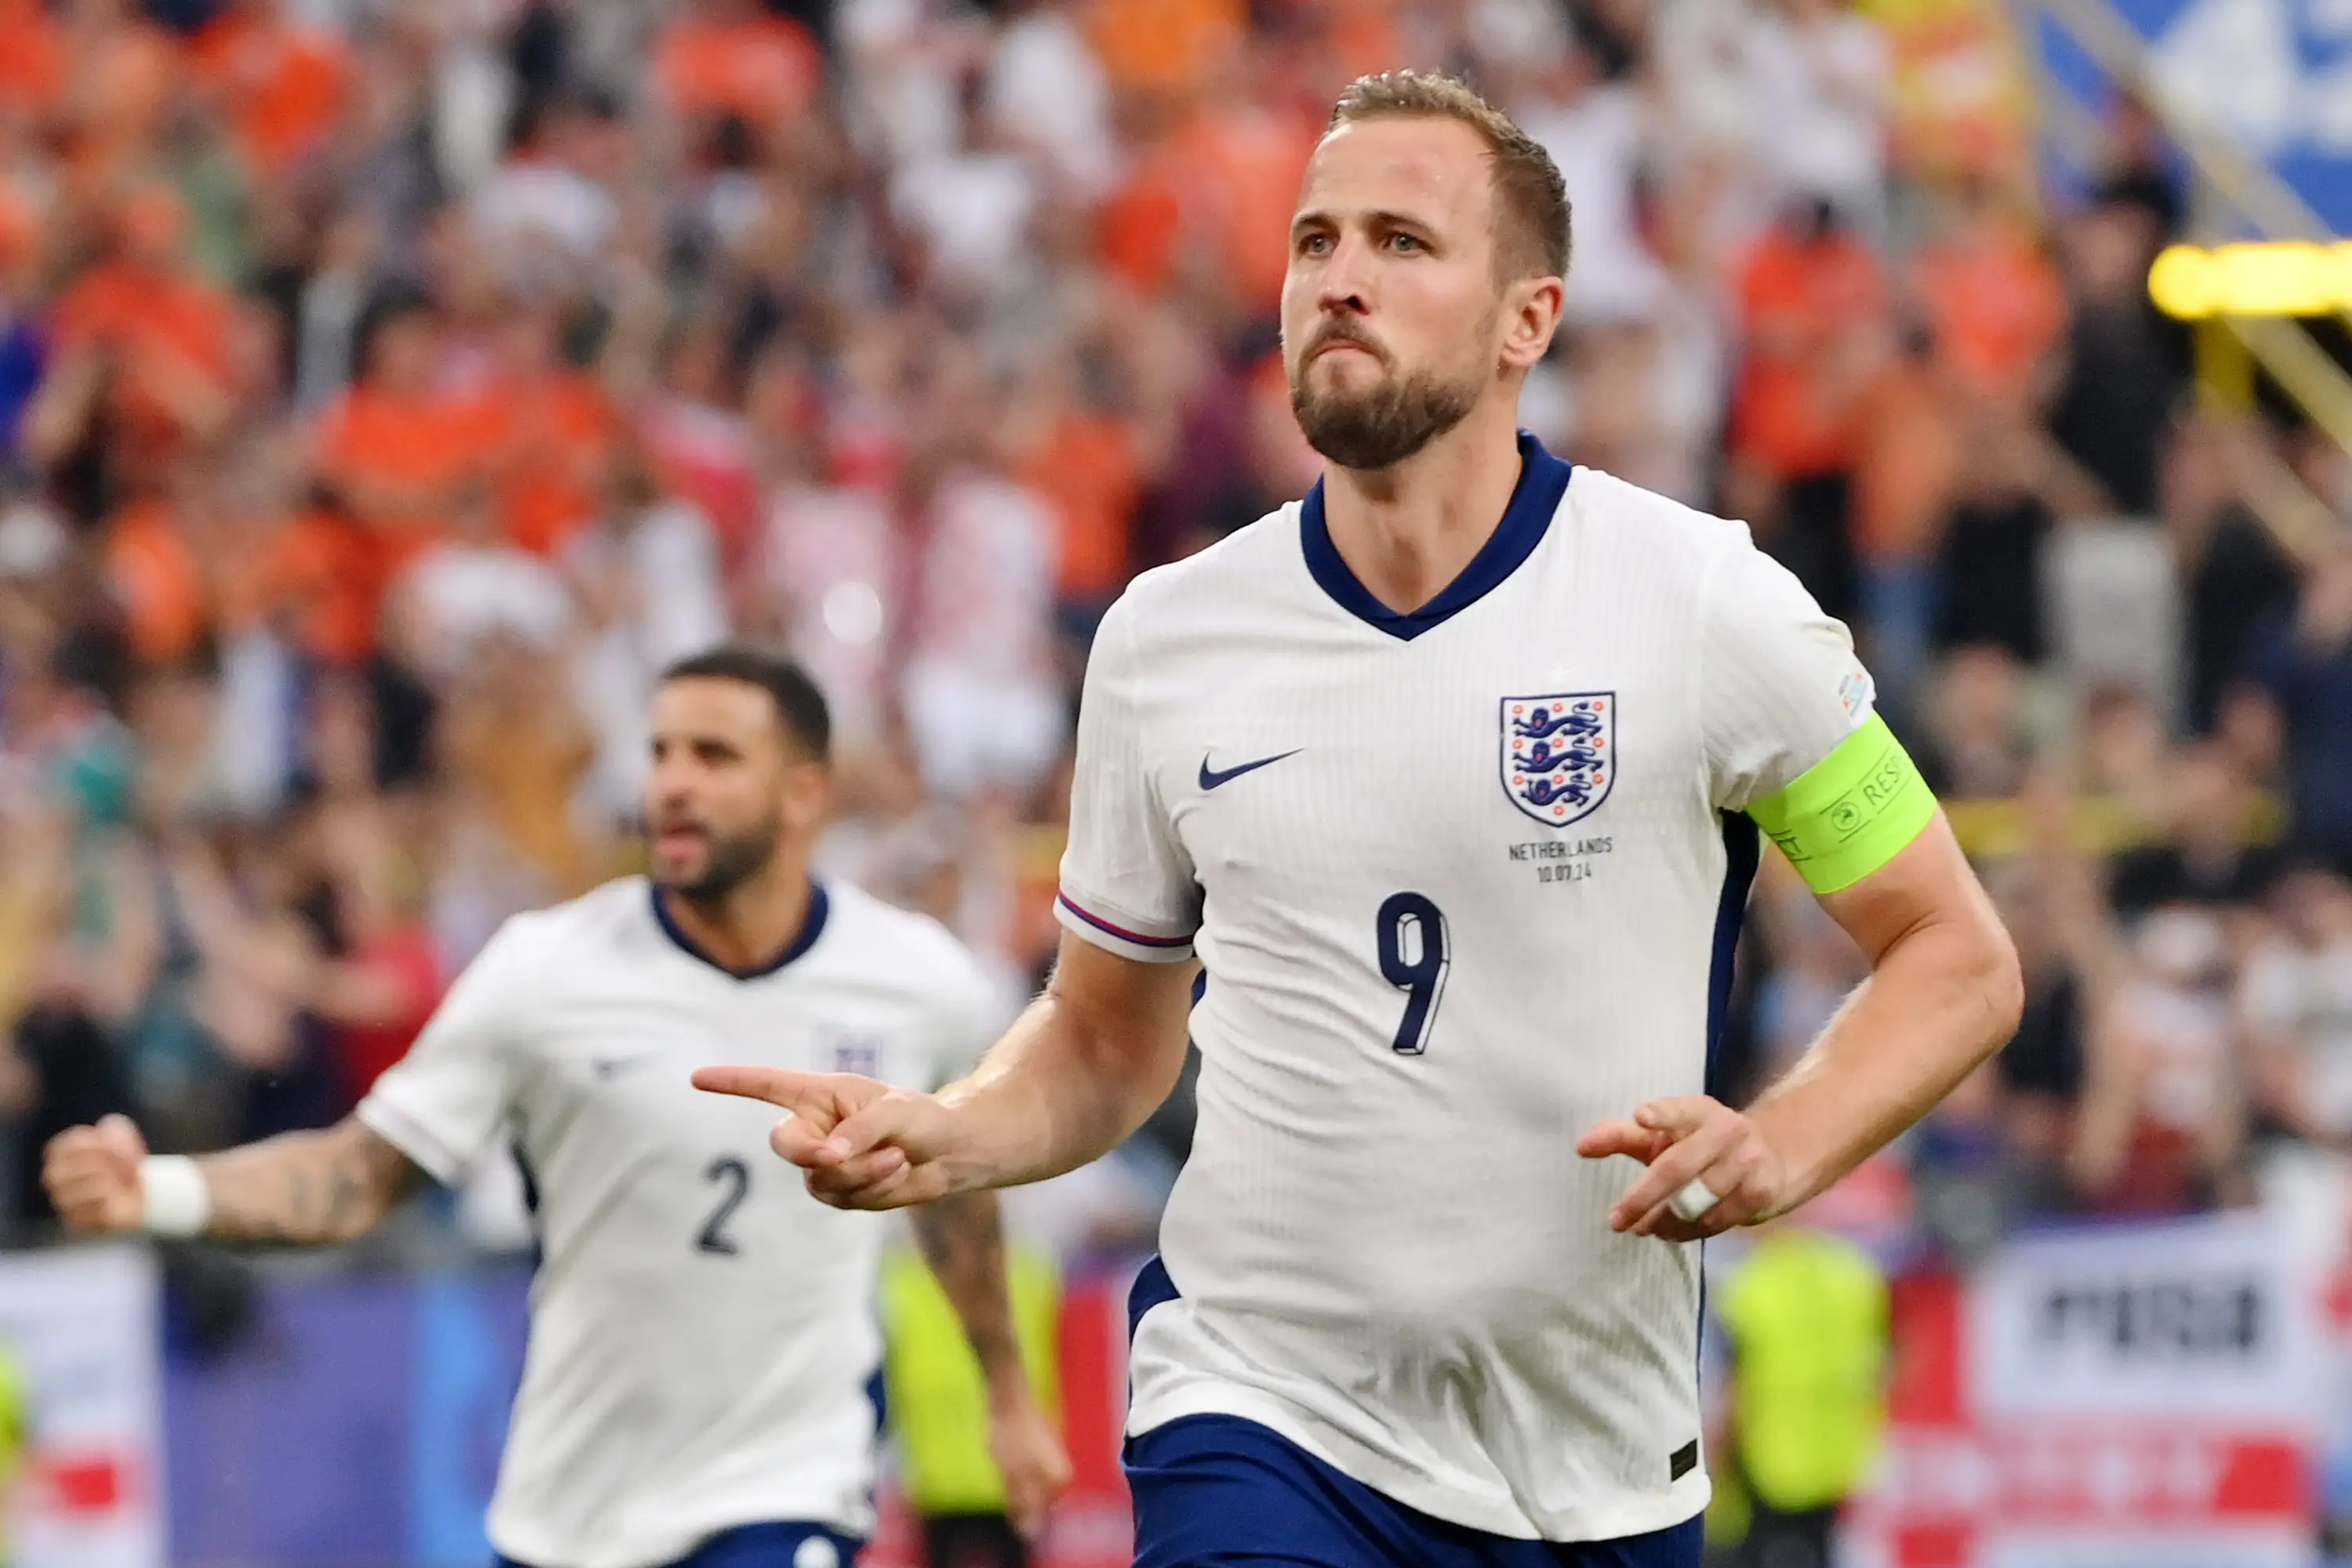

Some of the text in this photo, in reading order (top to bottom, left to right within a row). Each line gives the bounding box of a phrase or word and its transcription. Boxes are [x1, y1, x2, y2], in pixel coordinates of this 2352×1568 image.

[1508, 837, 1613, 861] NETHERLANDS
[1377, 891, 1450, 1055] 9
[695, 1156, 751, 1254] 2
